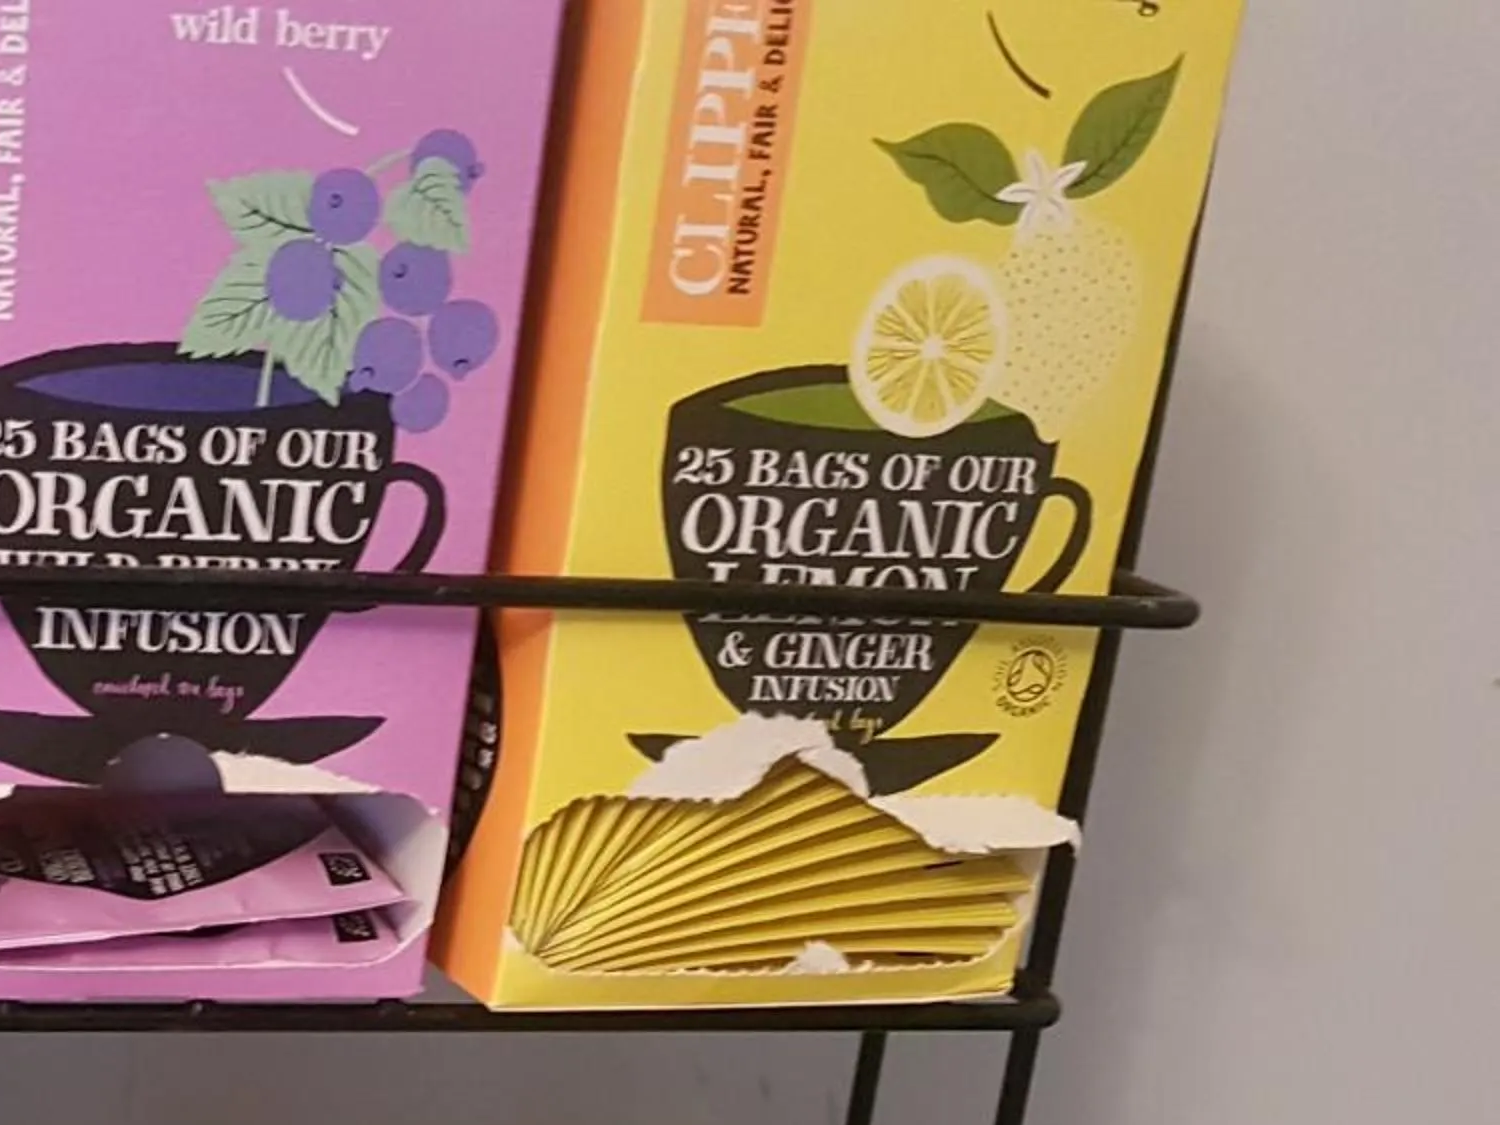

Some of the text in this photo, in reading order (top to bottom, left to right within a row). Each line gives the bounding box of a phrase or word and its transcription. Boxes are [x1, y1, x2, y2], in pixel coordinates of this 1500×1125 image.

[171, 10, 391, 61] wild berry
[758, 75, 786, 94] &
[748, 103, 779, 160] FAIR
[727, 169, 772, 295] NATURAL,
[49, 421, 187, 465] BAGS
[201, 426, 266, 467] OF
[276, 429, 382, 472] OUR
[673, 447, 1040, 497] 25 BAGS OF OUR
[680, 493, 1020, 561] ORGANIC
[32, 606, 306, 656] INFUSION
[717, 630, 936, 672] & GINGER
[748, 675, 901, 703] INFUSION
